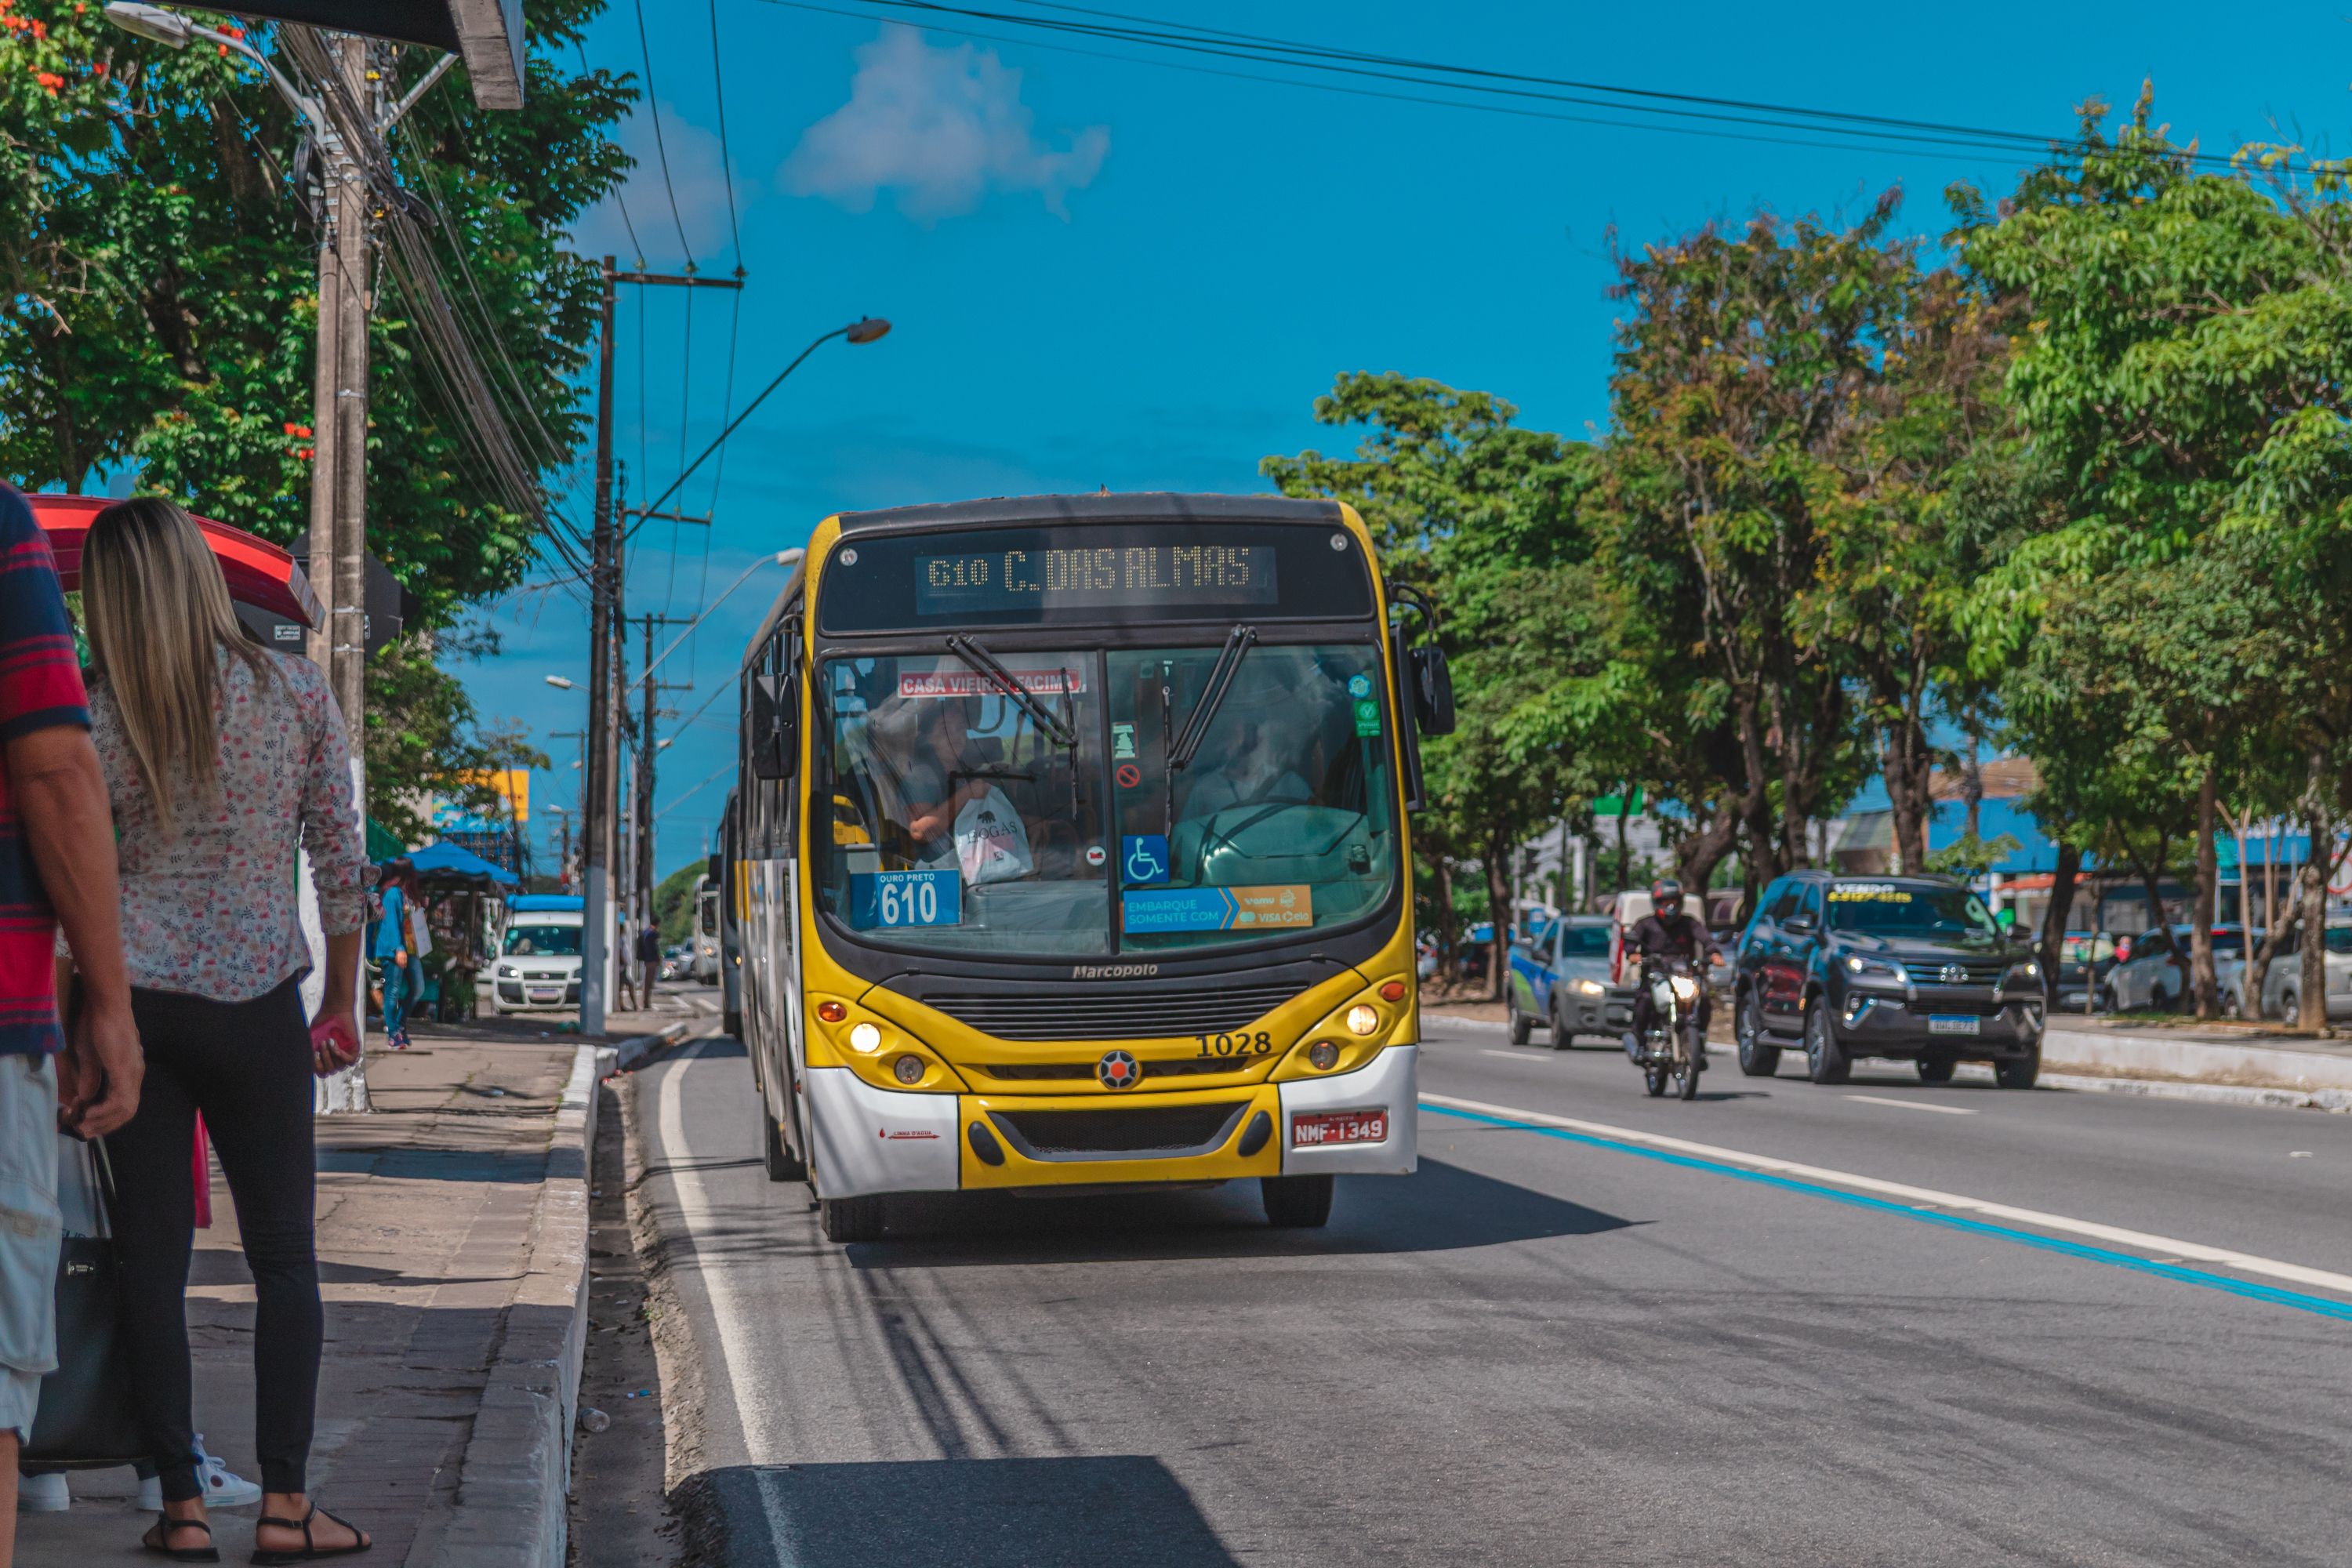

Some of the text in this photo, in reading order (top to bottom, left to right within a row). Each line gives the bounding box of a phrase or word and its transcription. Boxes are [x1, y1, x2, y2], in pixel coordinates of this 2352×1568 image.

[927, 559, 988, 587] 610
[1124, 545, 1250, 589] ALMAS
[904, 677, 946, 694] CASA
[1015, 673, 1074, 692] FACIMA
[907, 873, 935, 882] PRETO
[1834, 884, 1896, 894] VENDO
[881, 881, 937, 924] 610
[1128, 899, 1198, 913] EMBARQUE
[1128, 911, 1219, 925] SOMENTE COM
[1258, 913, 1281, 923] VISA
[1073, 964, 1159, 978] Marcopolo
[1196, 1031, 1272, 1058] 1028
